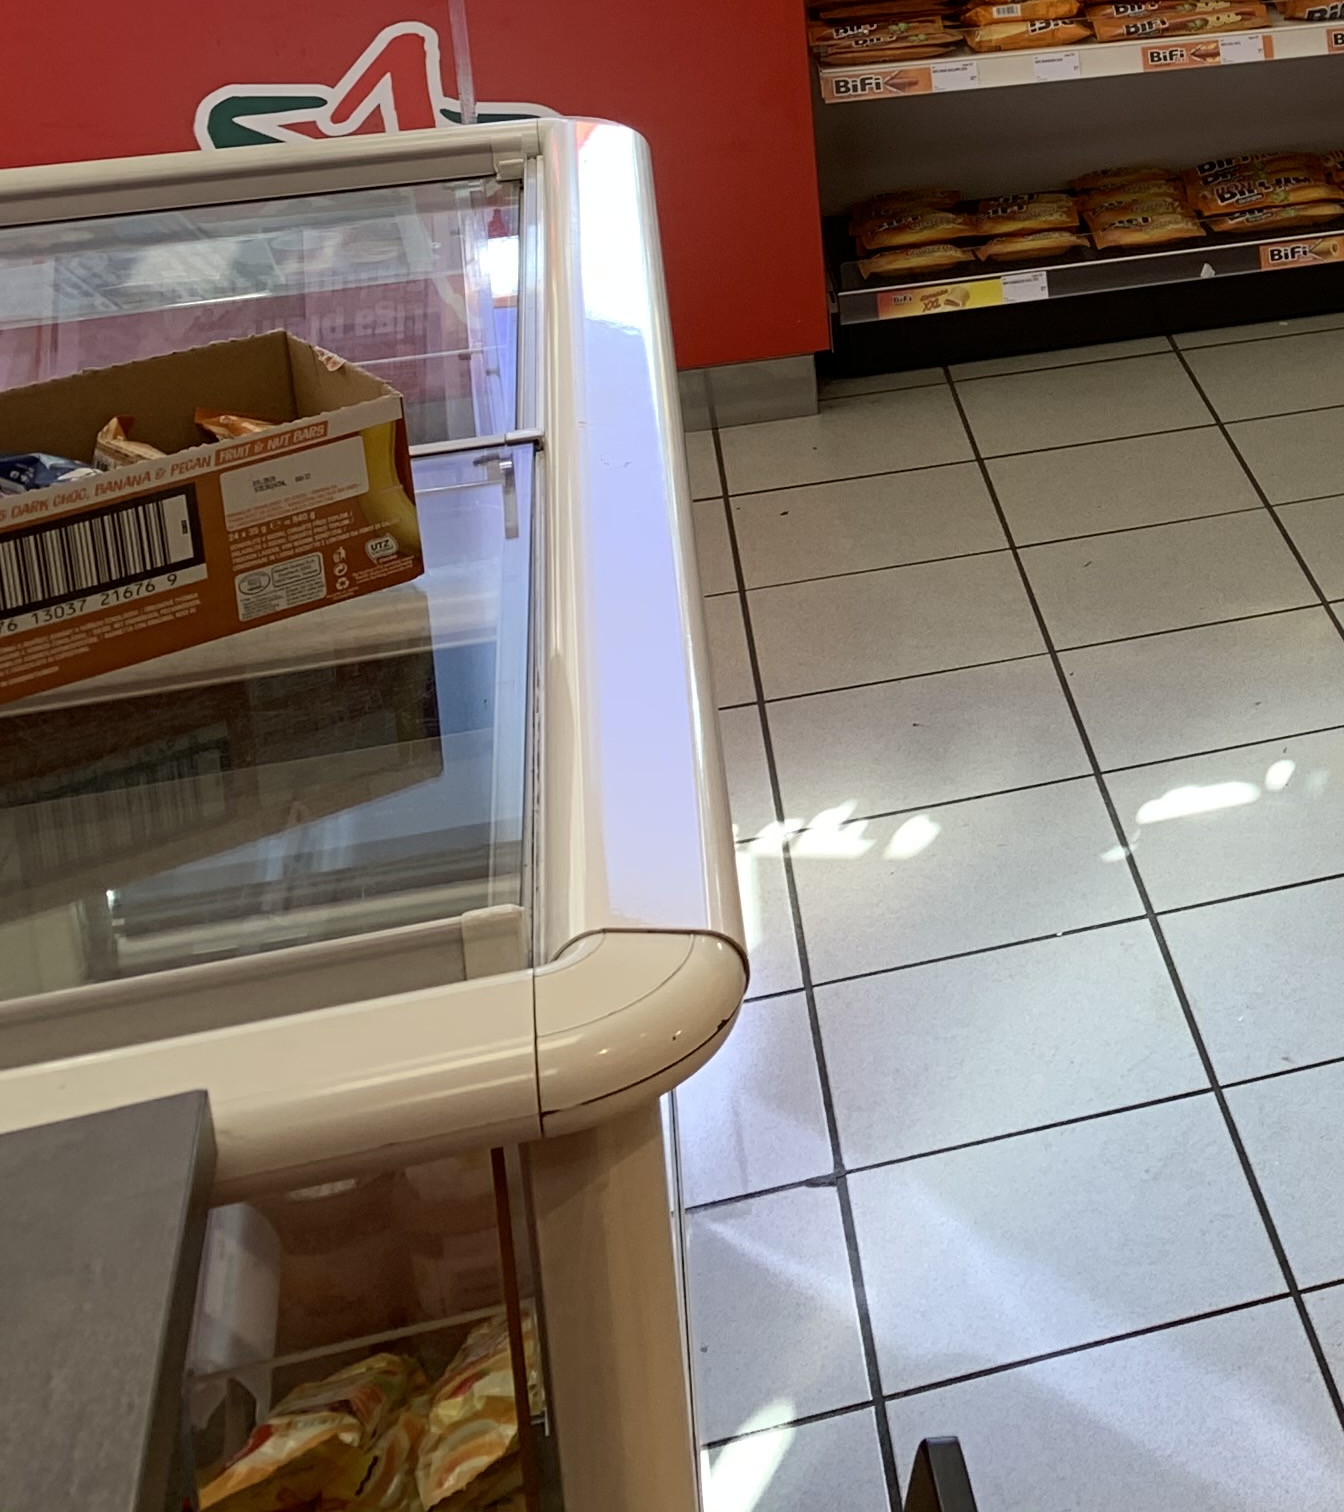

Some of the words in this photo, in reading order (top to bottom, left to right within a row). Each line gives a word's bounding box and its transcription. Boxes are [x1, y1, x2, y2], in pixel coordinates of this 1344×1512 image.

[834, 76, 884, 94] BiFi
[1269, 244, 1308, 263] BiFi
[12, 500, 49, 517] DARK
[53, 488, 89, 504] CHOC,
[96, 473, 151, 494] BANANA
[155, 468, 167, 480] &
[170, 456, 211, 476] PECAN
[220, 445, 250, 463] FRUIT
[254, 444, 264, 454] &
[268, 435, 290, 451] NUT
[294, 425, 325, 443] BARS
[371, 539, 390, 552] UTZ
[32, 600, 87, 623] 13037
[100, 581, 155, 606] 21676
[167, 574, 178, 586] 9
